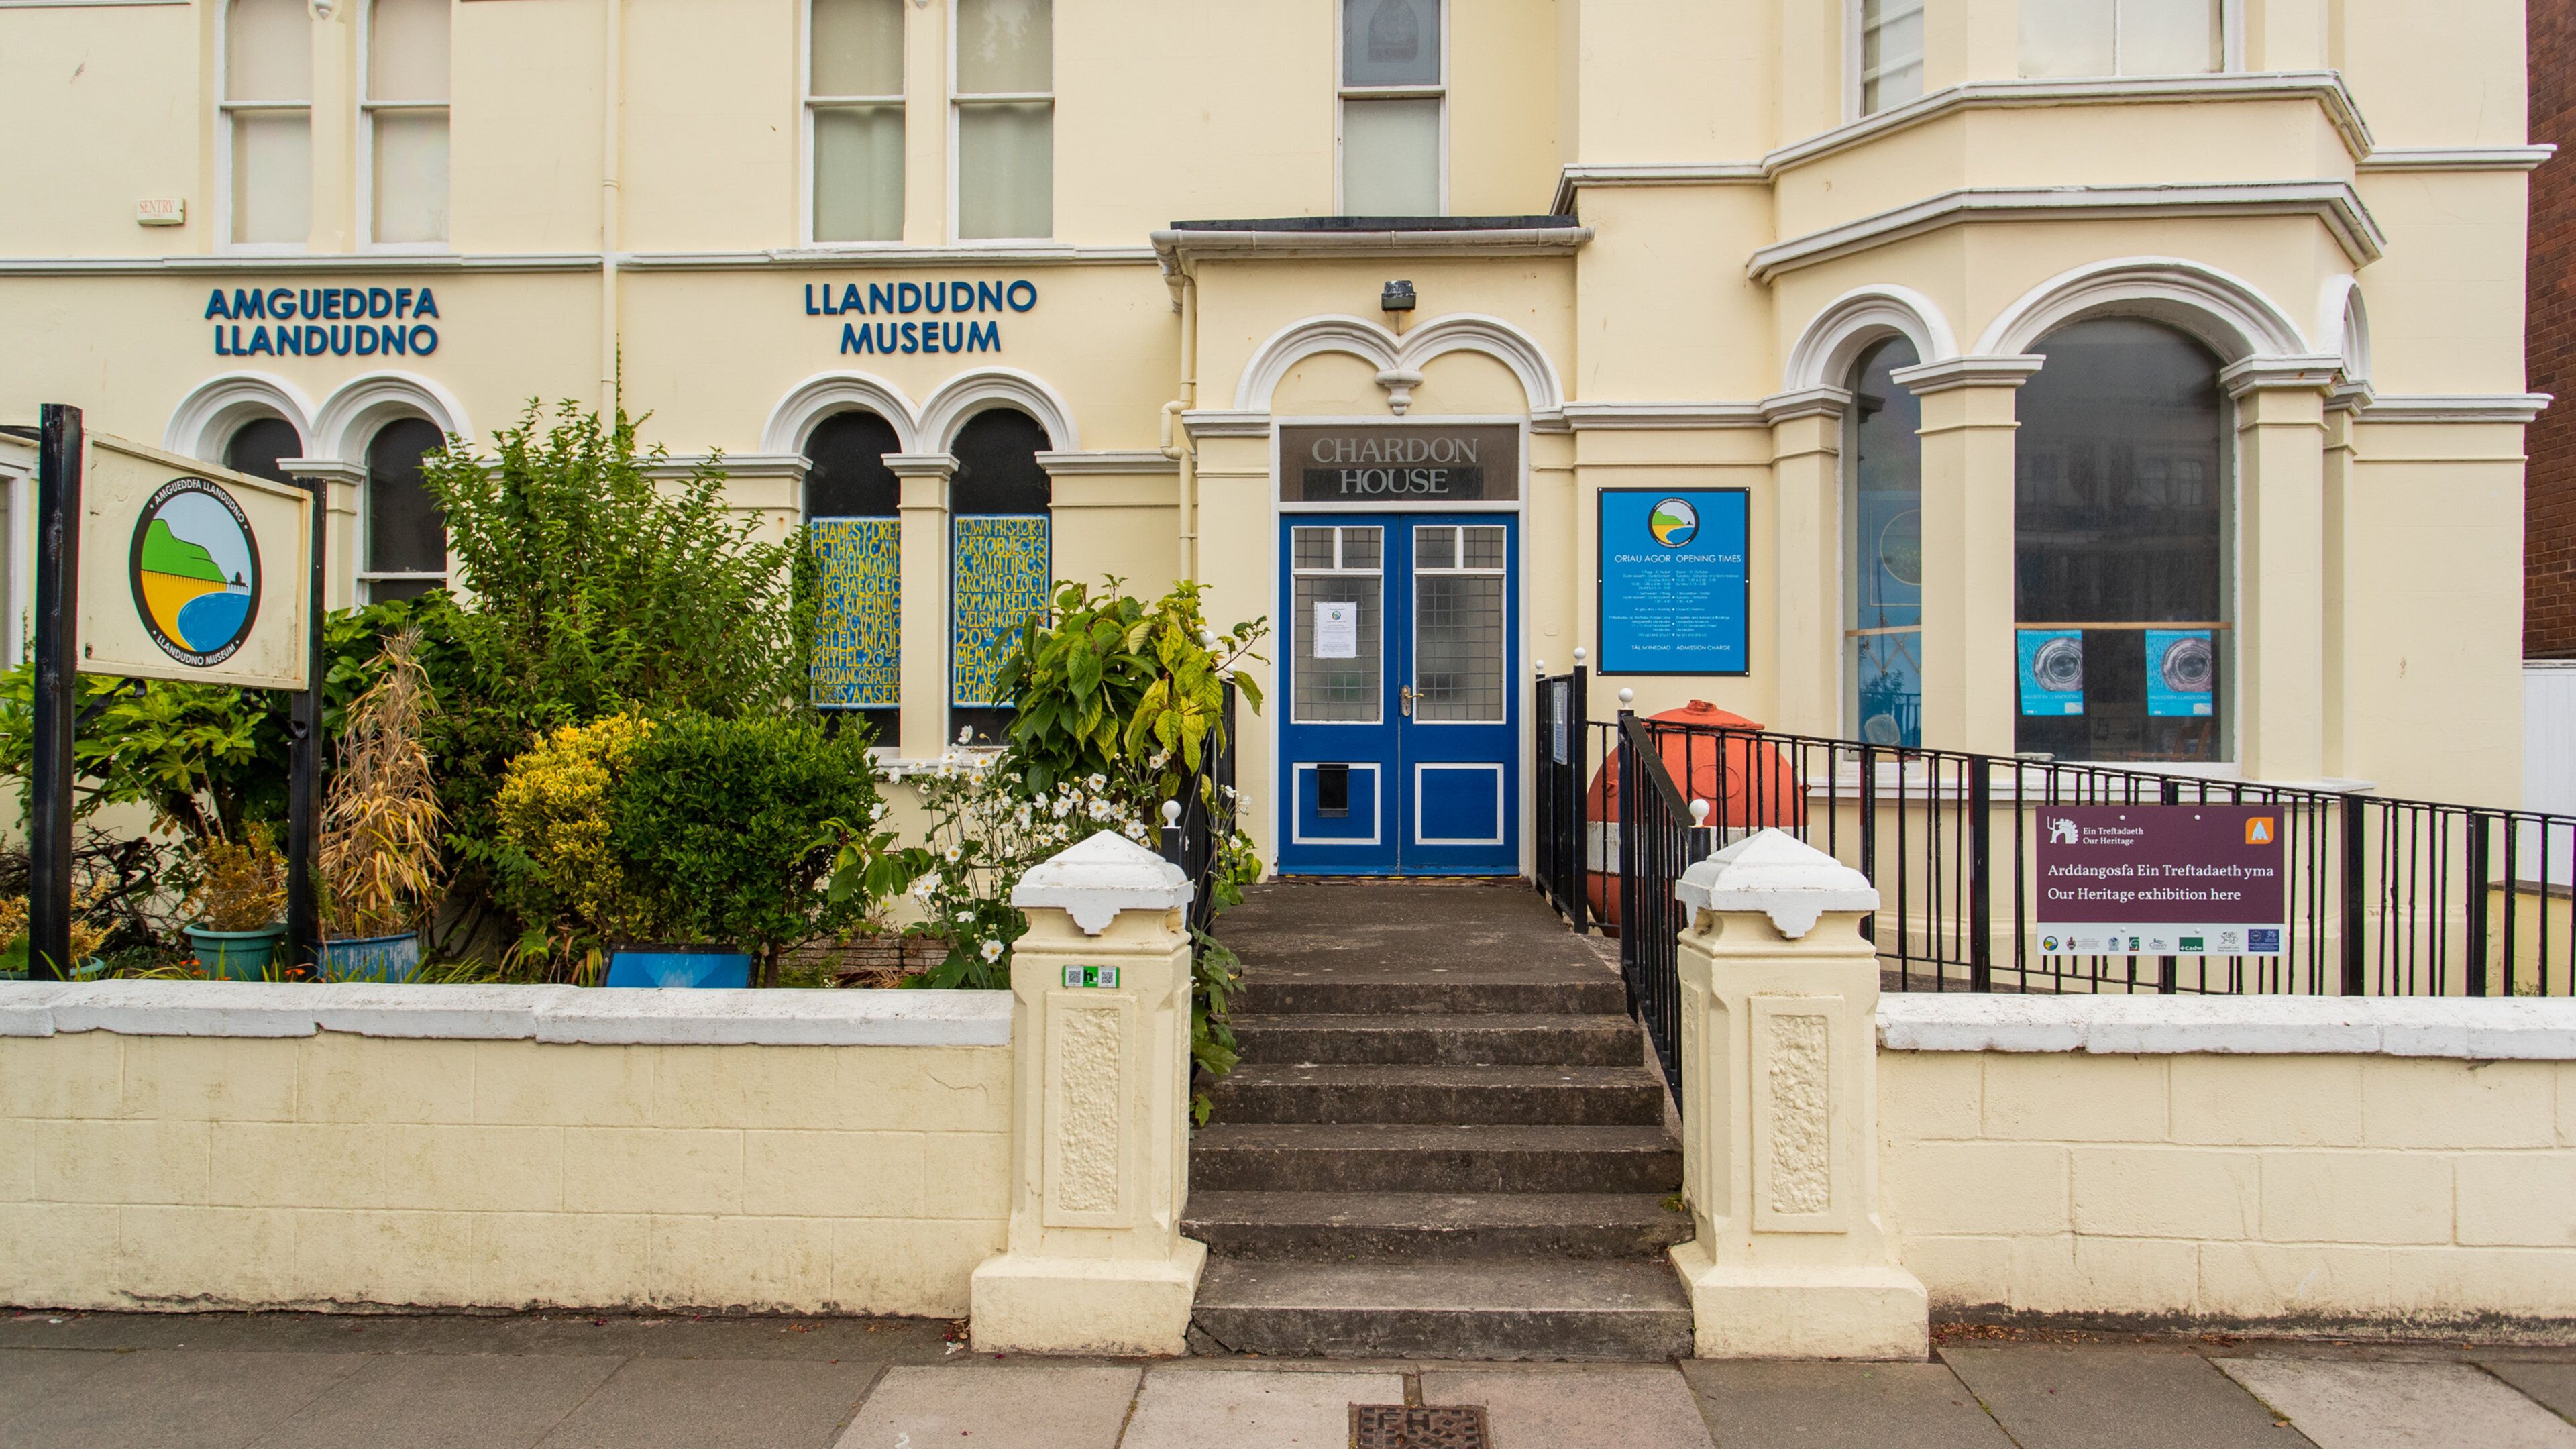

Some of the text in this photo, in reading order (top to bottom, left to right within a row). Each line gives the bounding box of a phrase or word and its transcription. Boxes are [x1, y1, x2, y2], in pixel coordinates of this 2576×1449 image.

[139, 199, 176, 213] SENTRY
[204, 288, 440, 320] AMGUEDDFA
[804, 280, 1038, 316] LLANDUDNO
[215, 324, 439, 356] LLANDUDNO
[840, 321, 1002, 354] MUSEUM
[1311, 437, 1479, 464] CHARDON
[1340, 468, 1449, 494] HOUSE
[154, 478, 245, 523] AMGUEDDFA LLANDUDNO
[957, 519, 1046, 536] TOWN HISTORY
[813, 539, 901, 559] PETHAU CAIN
[957, 535, 1047, 556] ART OBJECTS
[957, 555, 968, 574] &
[1614, 555, 1671, 563] ORIAU AGOR
[1676, 555, 1741, 563] OPENING TIMES
[957, 573, 1046, 592] ARCHAEOLOGY
[956, 592, 1046, 611] ROMAN RELICS
[956, 611, 995, 628] WELSH
[156, 634, 237, 665] LLANDUDNO MUSEUM
[813, 645, 861, 667] RHYFEL
[852, 684, 901, 704] AMSER
[2100, 837, 2135, 846] Heritage
[2047, 864, 2274, 880] Arddangosfa Ein Treftadaeth yma
[2047, 888, 2241, 903] Our Heritage exhibition here
